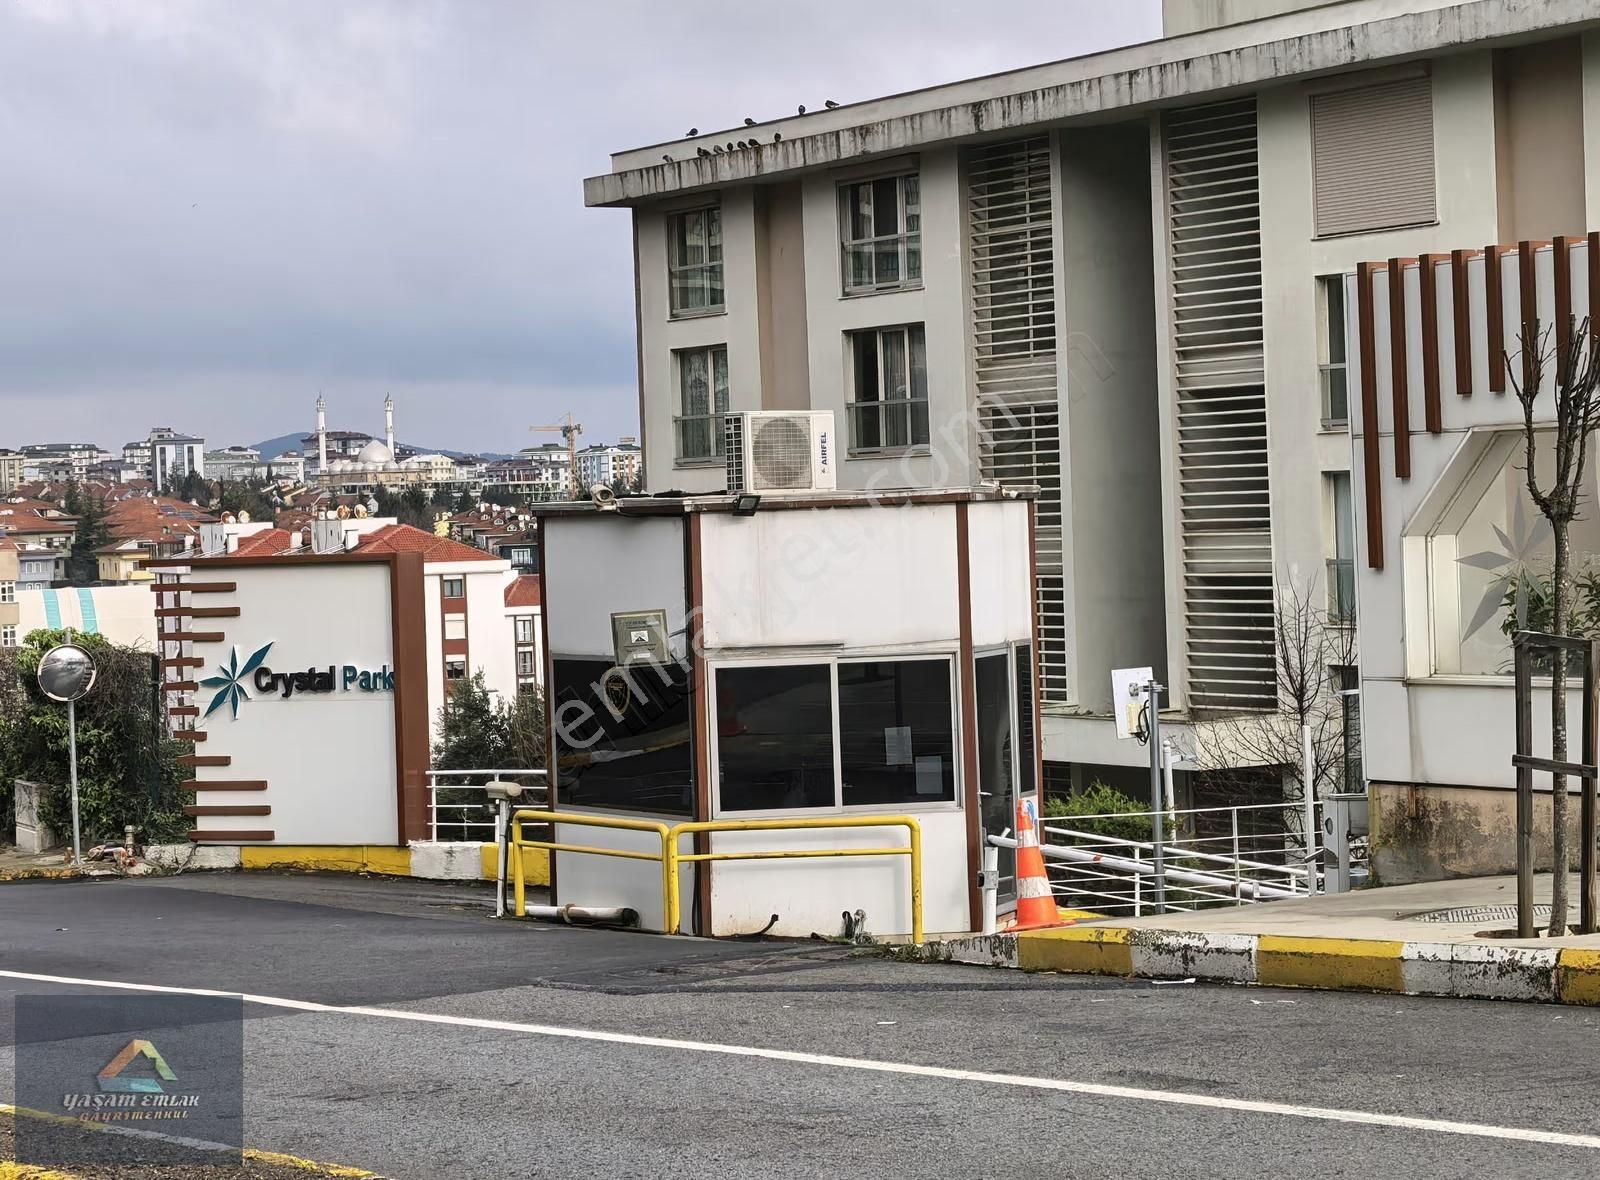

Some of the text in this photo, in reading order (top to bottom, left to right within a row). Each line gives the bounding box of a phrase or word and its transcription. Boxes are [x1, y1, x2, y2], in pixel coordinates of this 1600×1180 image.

[820, 431, 828, 466] AIRFEL
[254, 664, 395, 698] Crystal Park
